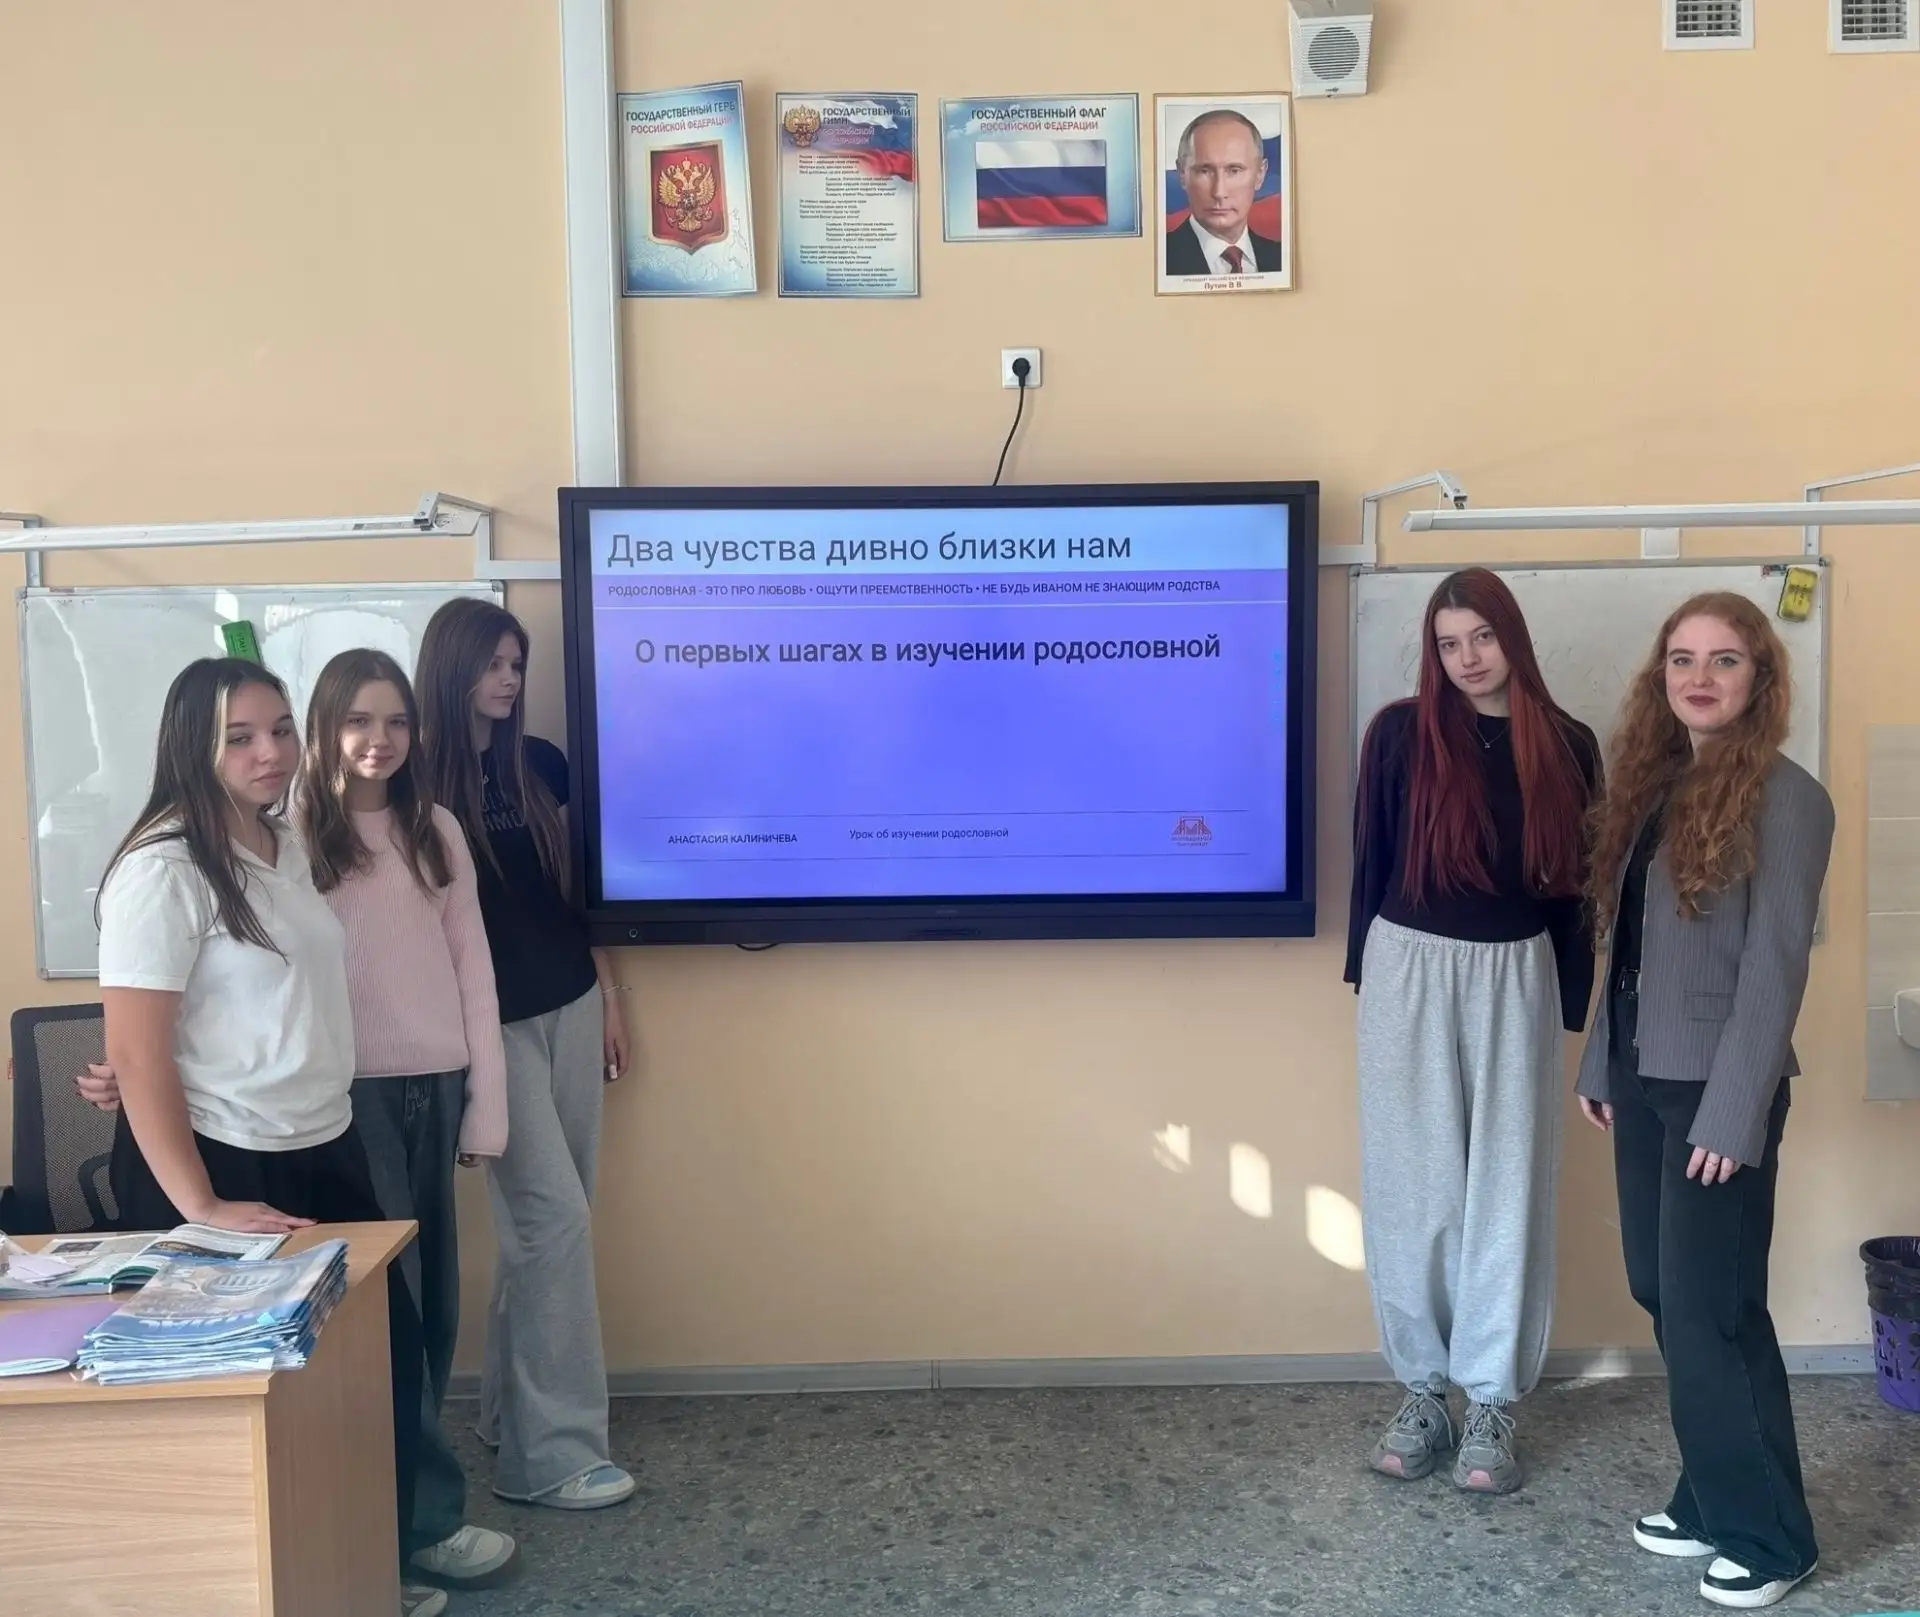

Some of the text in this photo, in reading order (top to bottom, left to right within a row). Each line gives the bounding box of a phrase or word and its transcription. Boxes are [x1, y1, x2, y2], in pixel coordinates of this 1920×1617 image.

[626, 101, 735, 122] ГОСУДАРСТВЕННЫЙ ГЕРБ
[822, 107, 911, 118] ГОСУДАРСТВЕННЫЙ
[971, 106, 1107, 120] ГОСУДАРСТВЕННЫЙ ФЛАГ
[630, 120, 686, 134] РОССИЙСКОЙ
[980, 120, 1099, 131] РОССИЙСКОЙ ФЕДЕРАЦИИ
[1204, 282, 1227, 290] Путин
[607, 531, 1131, 569] Два чувства дивно близки нам
[608, 585, 696, 597] РОДОСЛОВНАЯ
[705, 585, 728, 596] ЭТО
[731, 585, 755, 595] ПРО
[758, 584, 806, 595] ЛЮБОВЬ
[816, 584, 857, 597] ОЩУТИ
[860, 584, 973, 595] ПРЕЕМСТВЕННОСТЬ
[982, 583, 998, 594] НЕ
[1000, 583, 1030, 595] БУДЬ
[1033, 583, 1082, 594] ИВАНОМ
[1085, 582, 1100, 593] НЕ
[1102, 581, 1165, 594] ЗНАЮЩИМ
[1167, 581, 1220, 593] РОДСТВА
[635, 633, 1221, 669] О первых шагах в изучении родословной
[668, 833, 798, 845] АНАСТАСИЯ КАЛИНИЧЕВА
[849, 827, 1009, 840] Урок об изучении родословной
